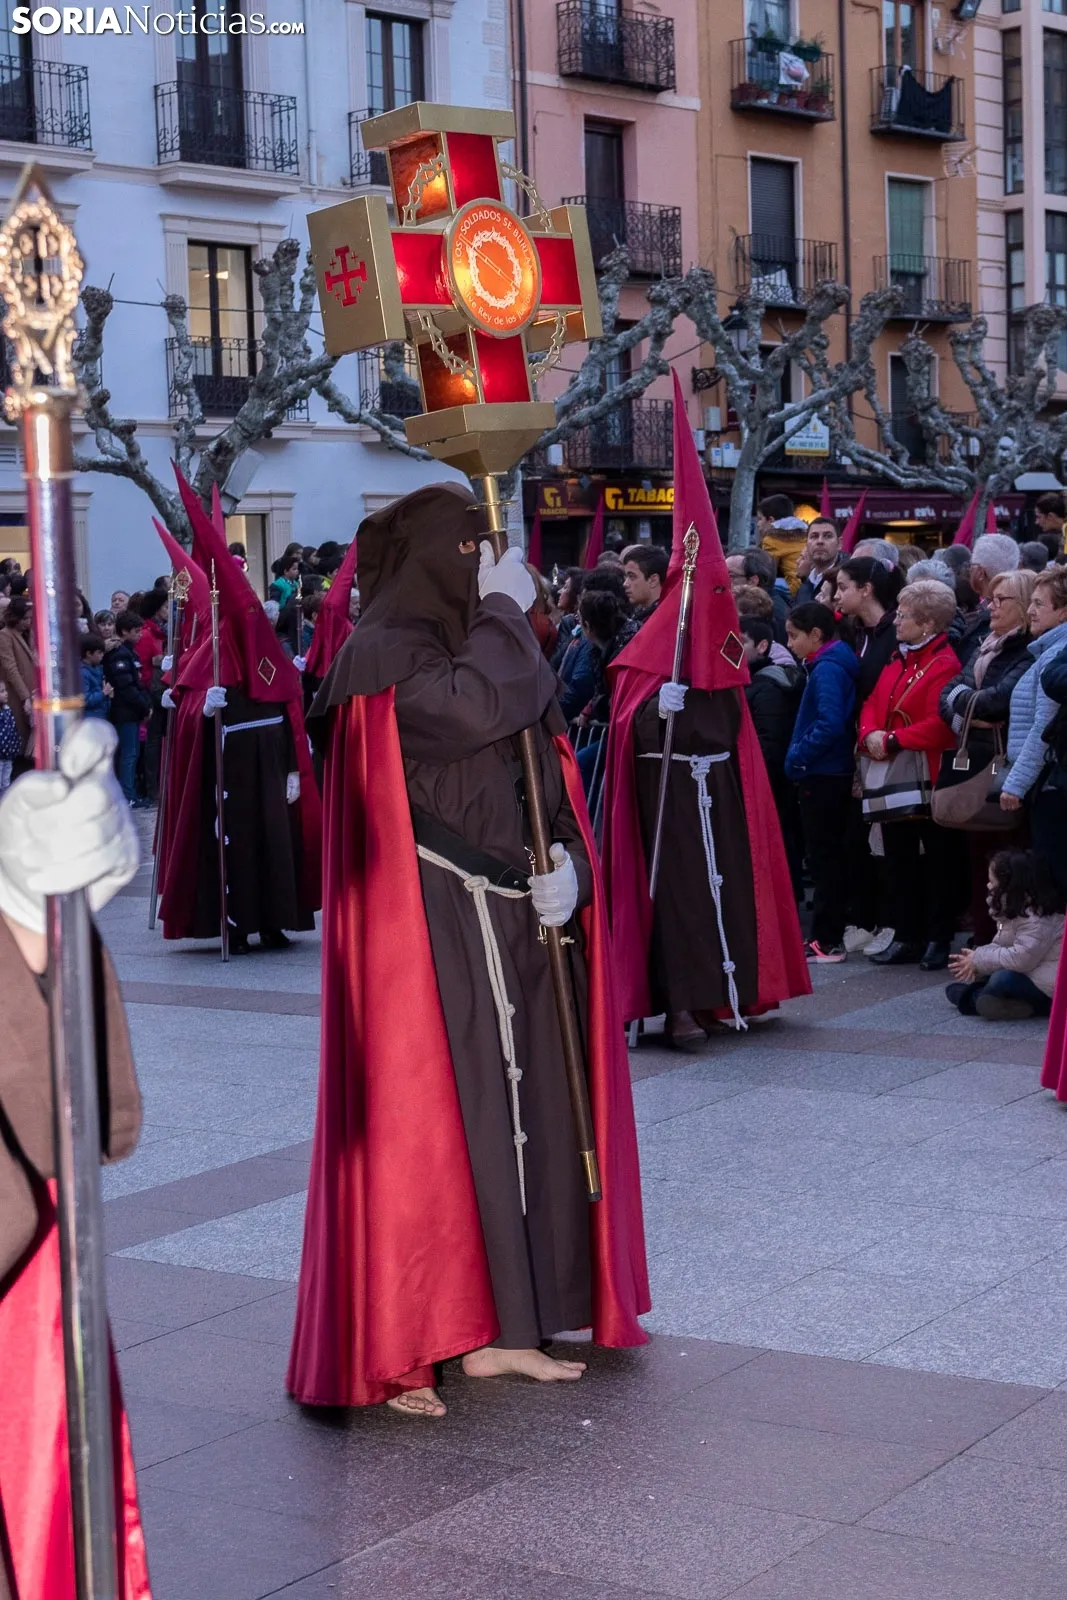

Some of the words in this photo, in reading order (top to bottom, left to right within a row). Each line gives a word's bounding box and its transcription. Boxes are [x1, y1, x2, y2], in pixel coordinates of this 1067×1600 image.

[455, 241, 463, 263] LOS
[460, 210, 501, 235] SOLDADOS
[502, 217, 513, 231] SE
[478, 308, 492, 323] Rey
[494, 316, 504, 325] de
[506, 315, 517, 324] los
